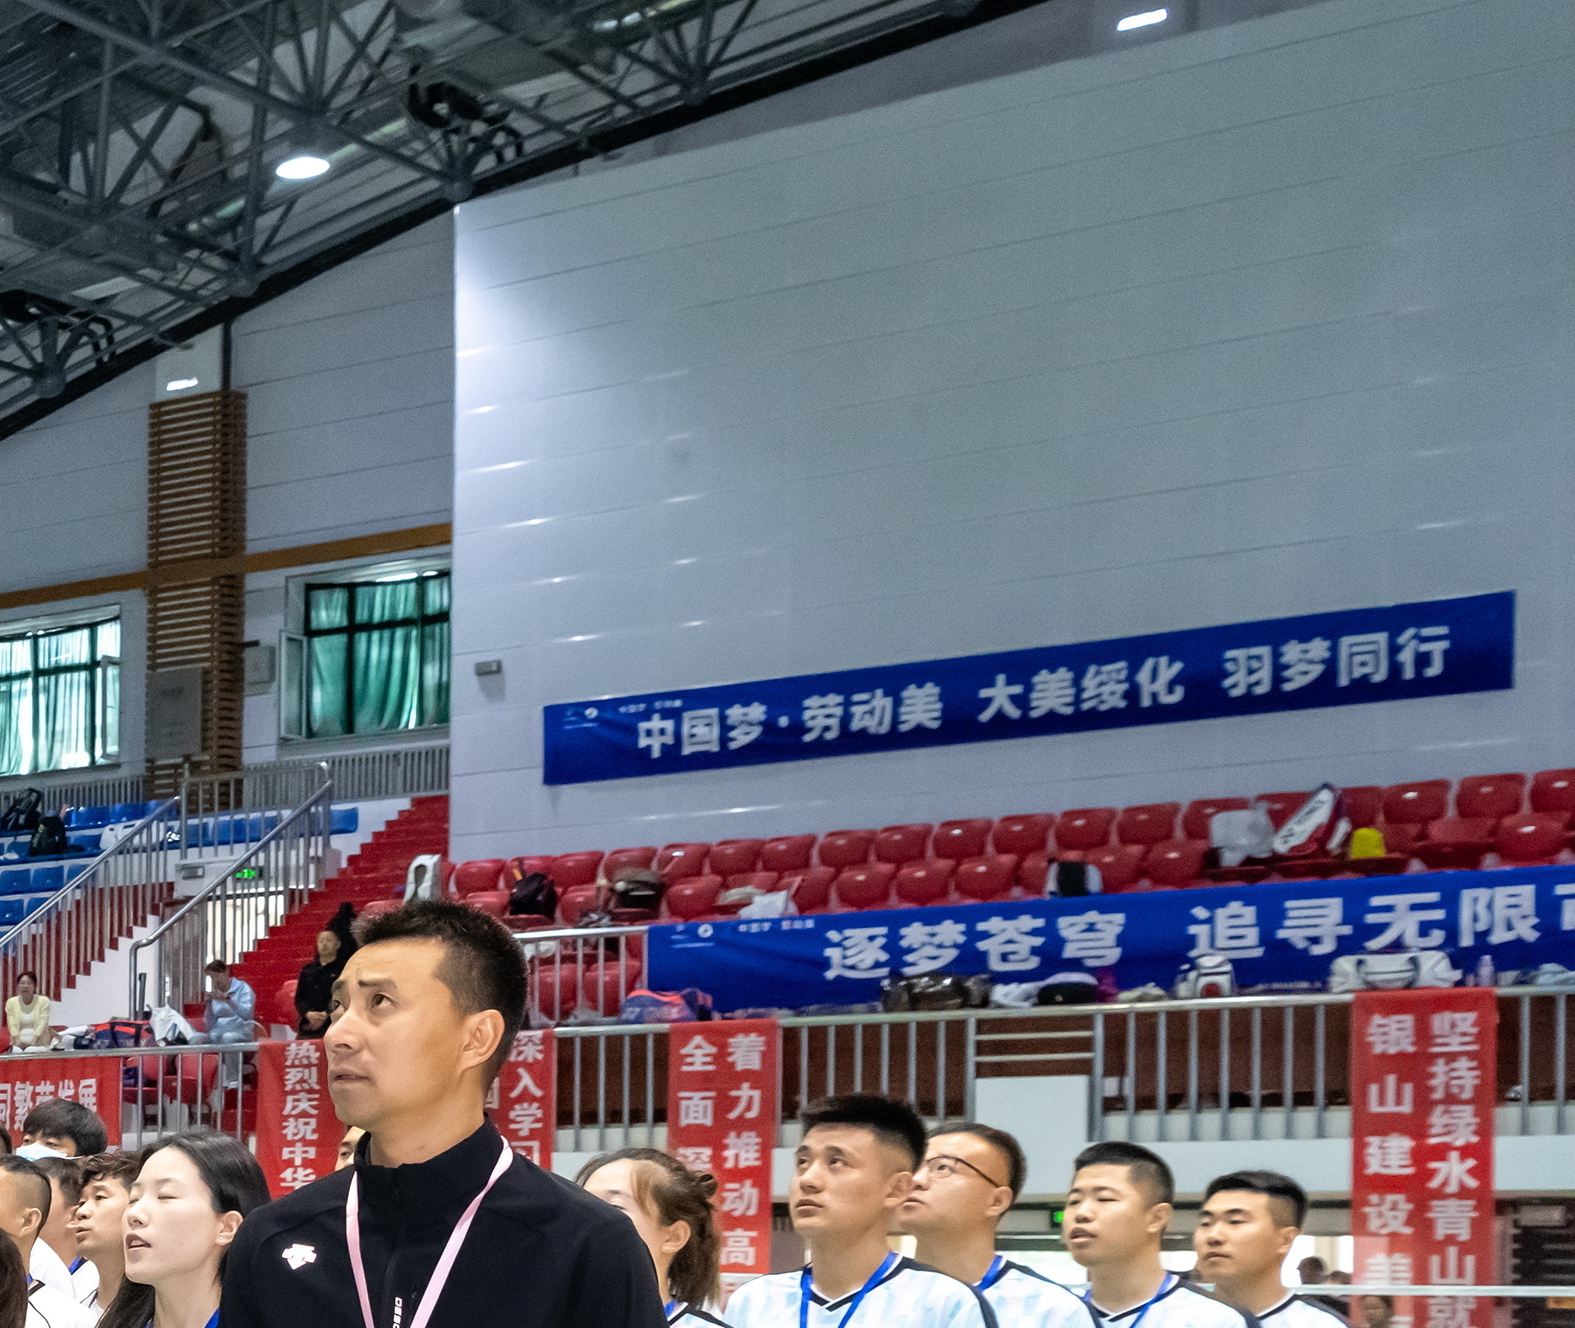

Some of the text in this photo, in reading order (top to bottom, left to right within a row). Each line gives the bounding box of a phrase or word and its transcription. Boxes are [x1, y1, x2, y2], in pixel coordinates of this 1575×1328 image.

[637, 626, 1451, 759] 中国梦·劳动美 大美绥化 羽梦同行
[823, 883, 1575, 980] 逐梦苍穹 追寻无限
[279, 1041, 321, 1192] 热烈庆祝中华
[720, 1032, 766, 1297] 着力推动高
